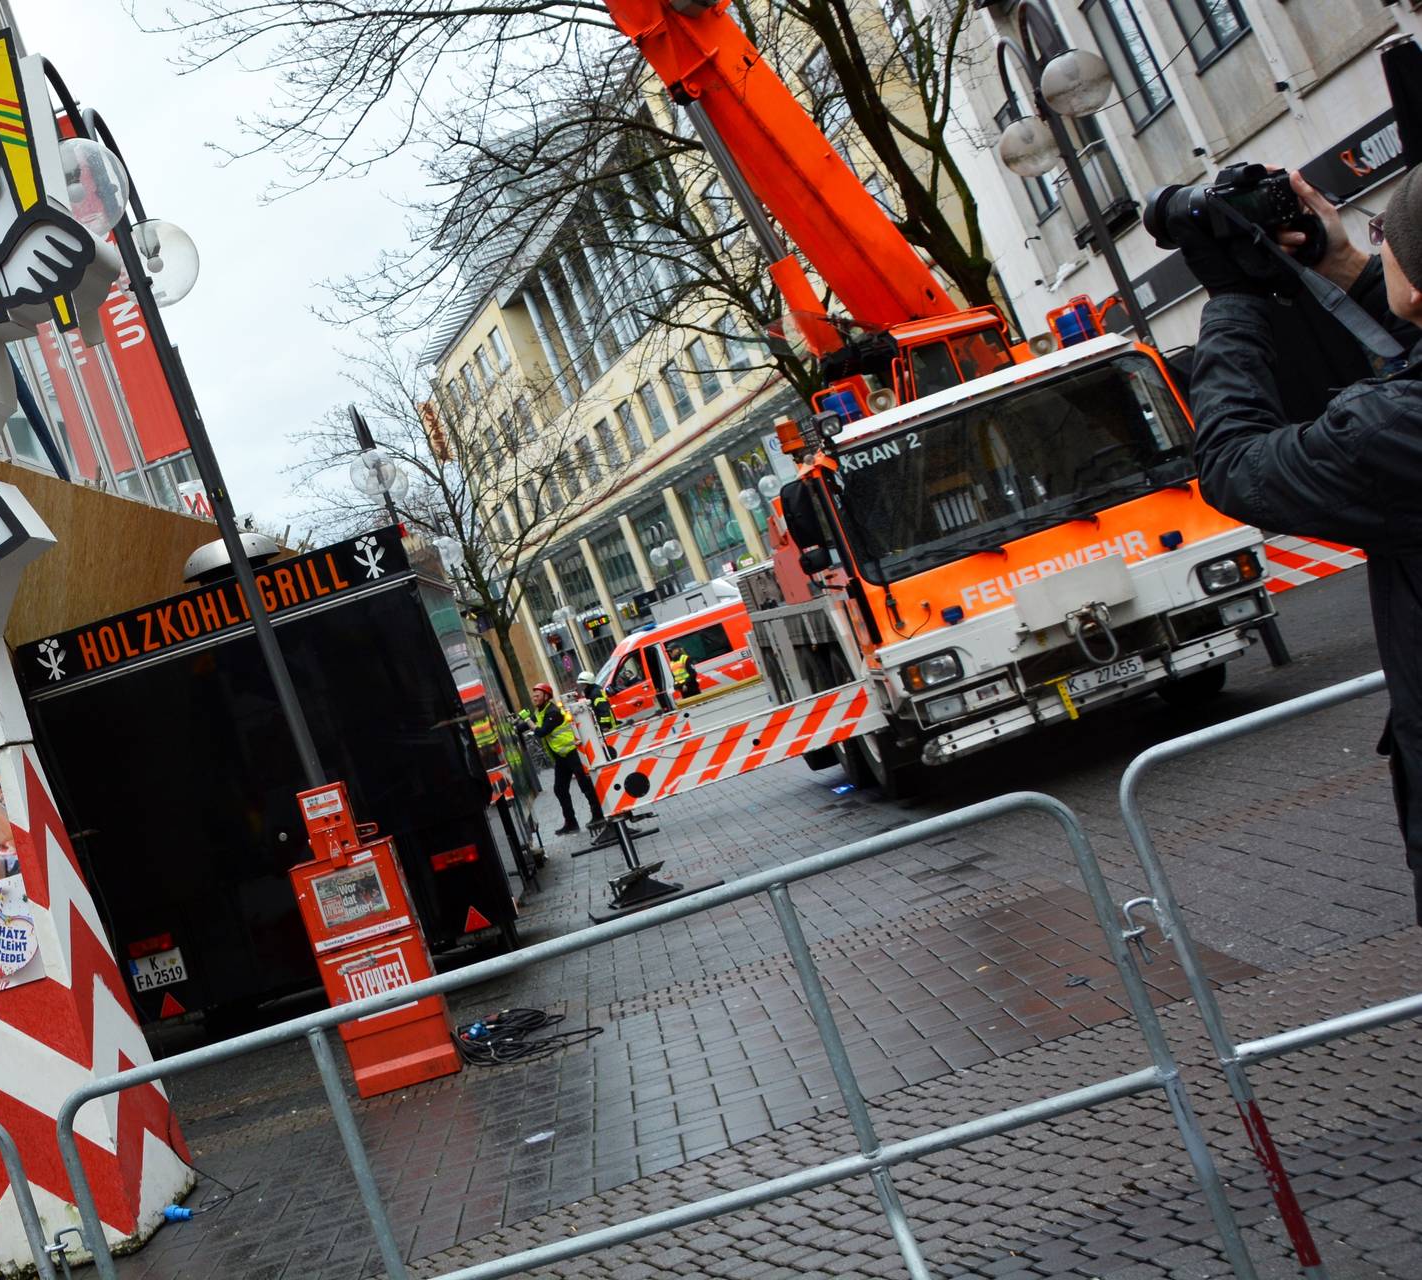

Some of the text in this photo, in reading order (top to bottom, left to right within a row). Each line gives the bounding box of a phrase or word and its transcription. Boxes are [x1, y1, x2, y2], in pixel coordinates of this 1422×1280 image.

[106, 289, 146, 349] UNI
[839, 432, 921, 470] KRAN 2
[960, 531, 1148, 610] FEUERWEHR
[77, 552, 350, 671] HOLZKOHLGRILL
[1067, 659, 1138, 695] K 27455
[136, 966, 183, 990] FA 2519
[149, 957, 159, 971] K
[351, 961, 407, 1001] EXPRESS
